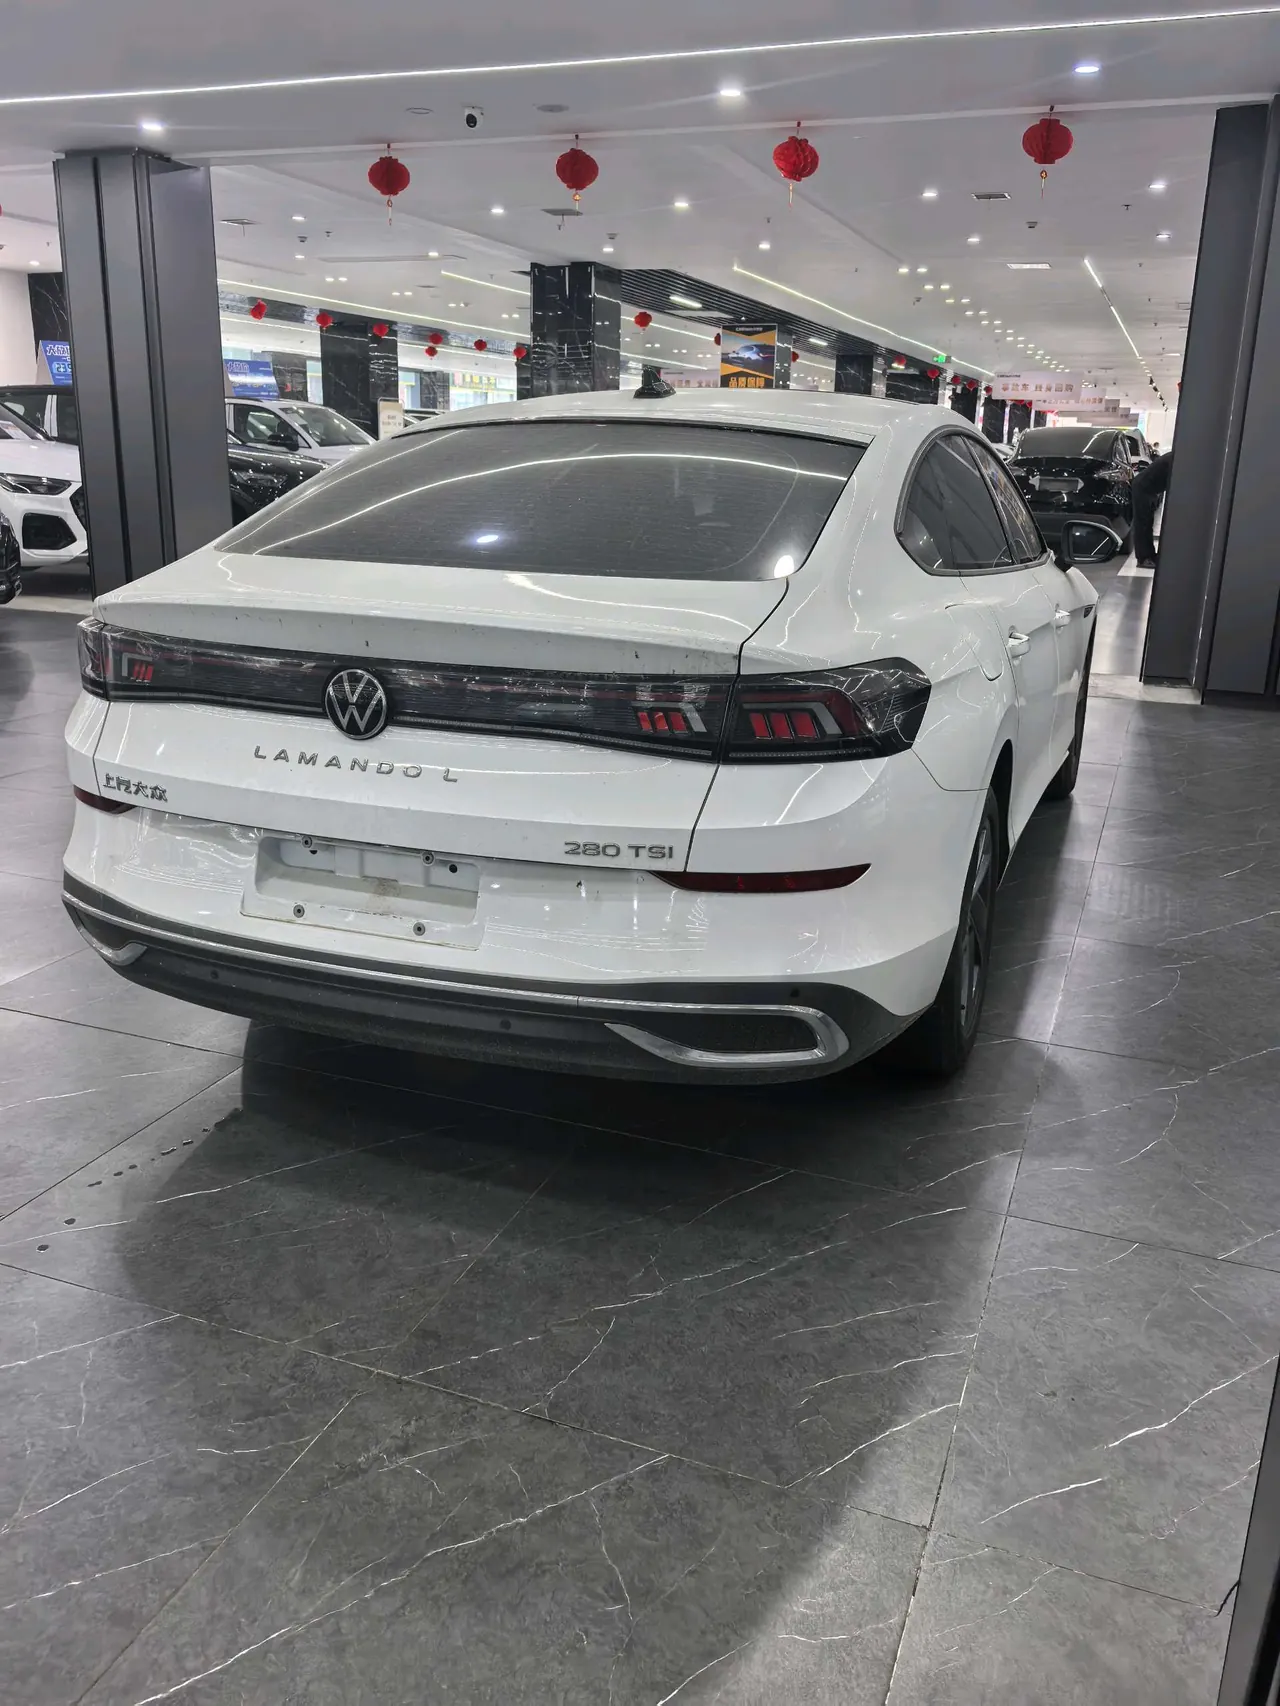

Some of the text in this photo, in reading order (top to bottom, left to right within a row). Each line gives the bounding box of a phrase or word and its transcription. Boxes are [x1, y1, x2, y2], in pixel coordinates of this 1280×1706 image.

[254, 746, 458, 782] LAMANDO L
[103, 773, 168, 802] 上汽大众
[564, 841, 674, 859] 280 TSI
